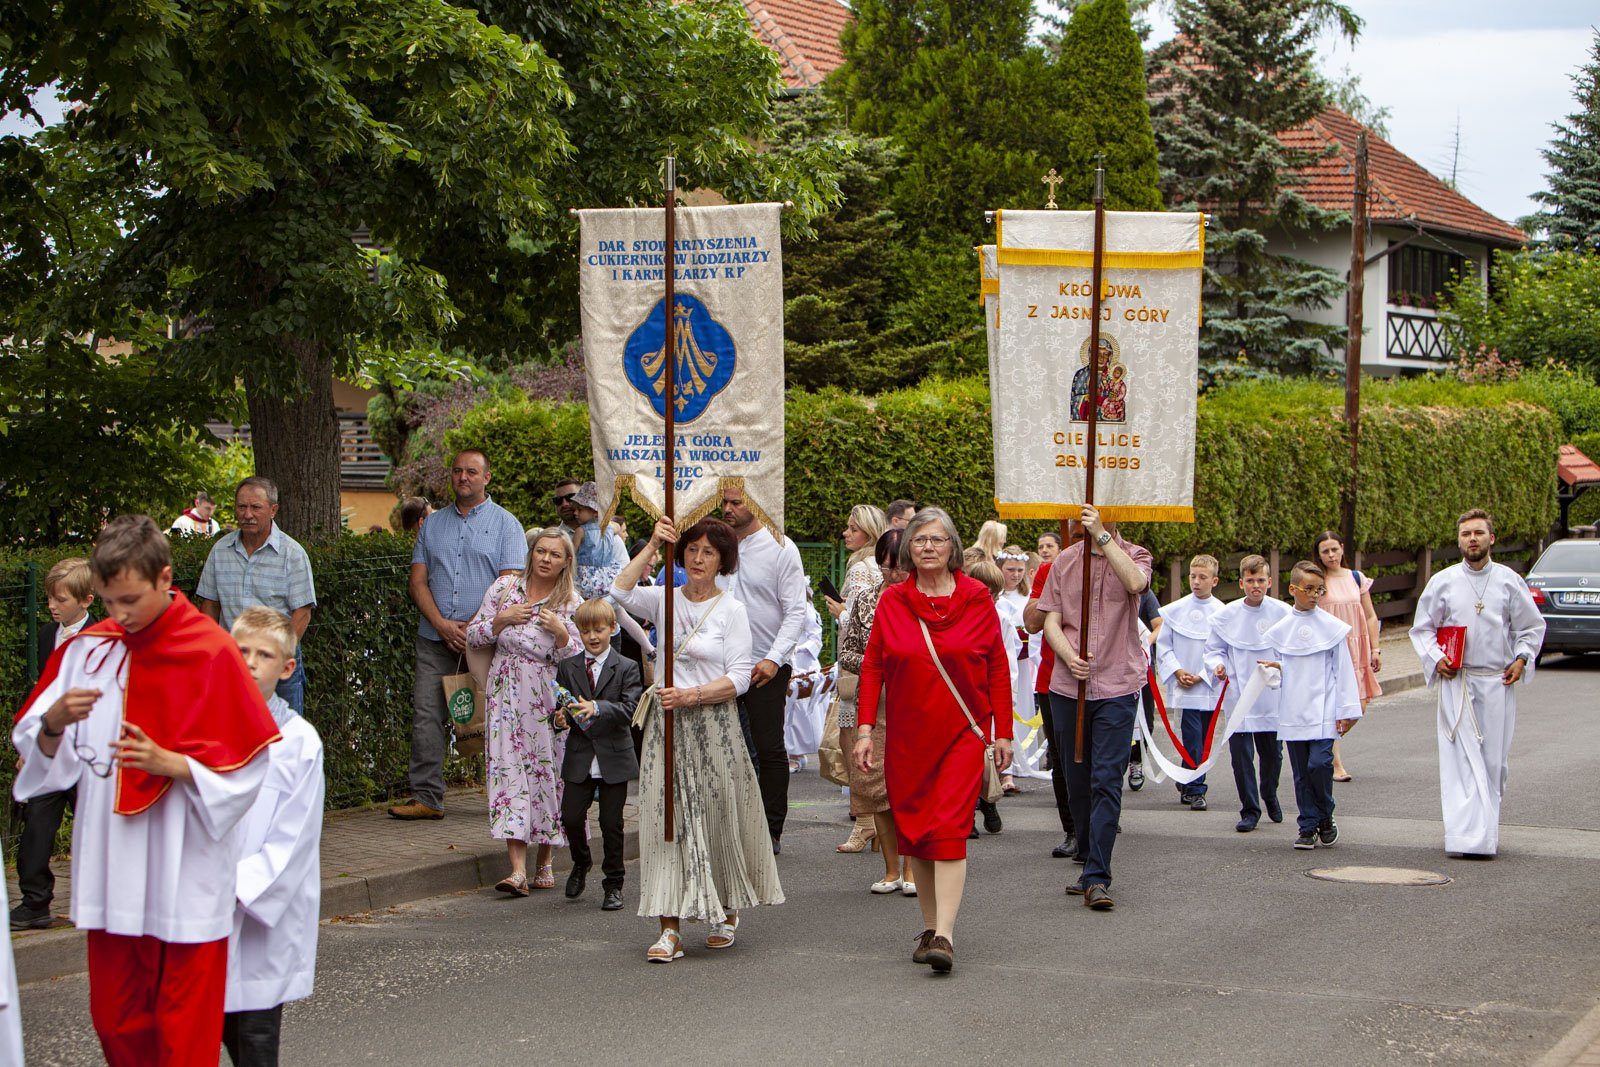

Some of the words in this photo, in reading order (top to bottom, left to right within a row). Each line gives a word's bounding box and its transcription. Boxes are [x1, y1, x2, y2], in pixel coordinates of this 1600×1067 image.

[599, 240, 625, 252] DAR
[588, 253, 687, 266] CUKIERNIKW
[692, 250, 770, 265] LODZIARZY
[622, 267, 719, 281] KARMLARZY
[1059, 280, 1142, 299] KRÓOWA
[1027, 304, 1038, 318] Z
[1050, 304, 1112, 321] JASNJ
[1123, 306, 1170, 323] GÓRY
[624, 435, 686, 447] JELEA
[693, 432, 733, 448] GÓRA
[1053, 431, 1141, 448] CIELICE
[689, 450, 761, 462] WROCŁAW
[655, 466, 703, 478] LPIEC
[662, 479, 693, 491] 197
